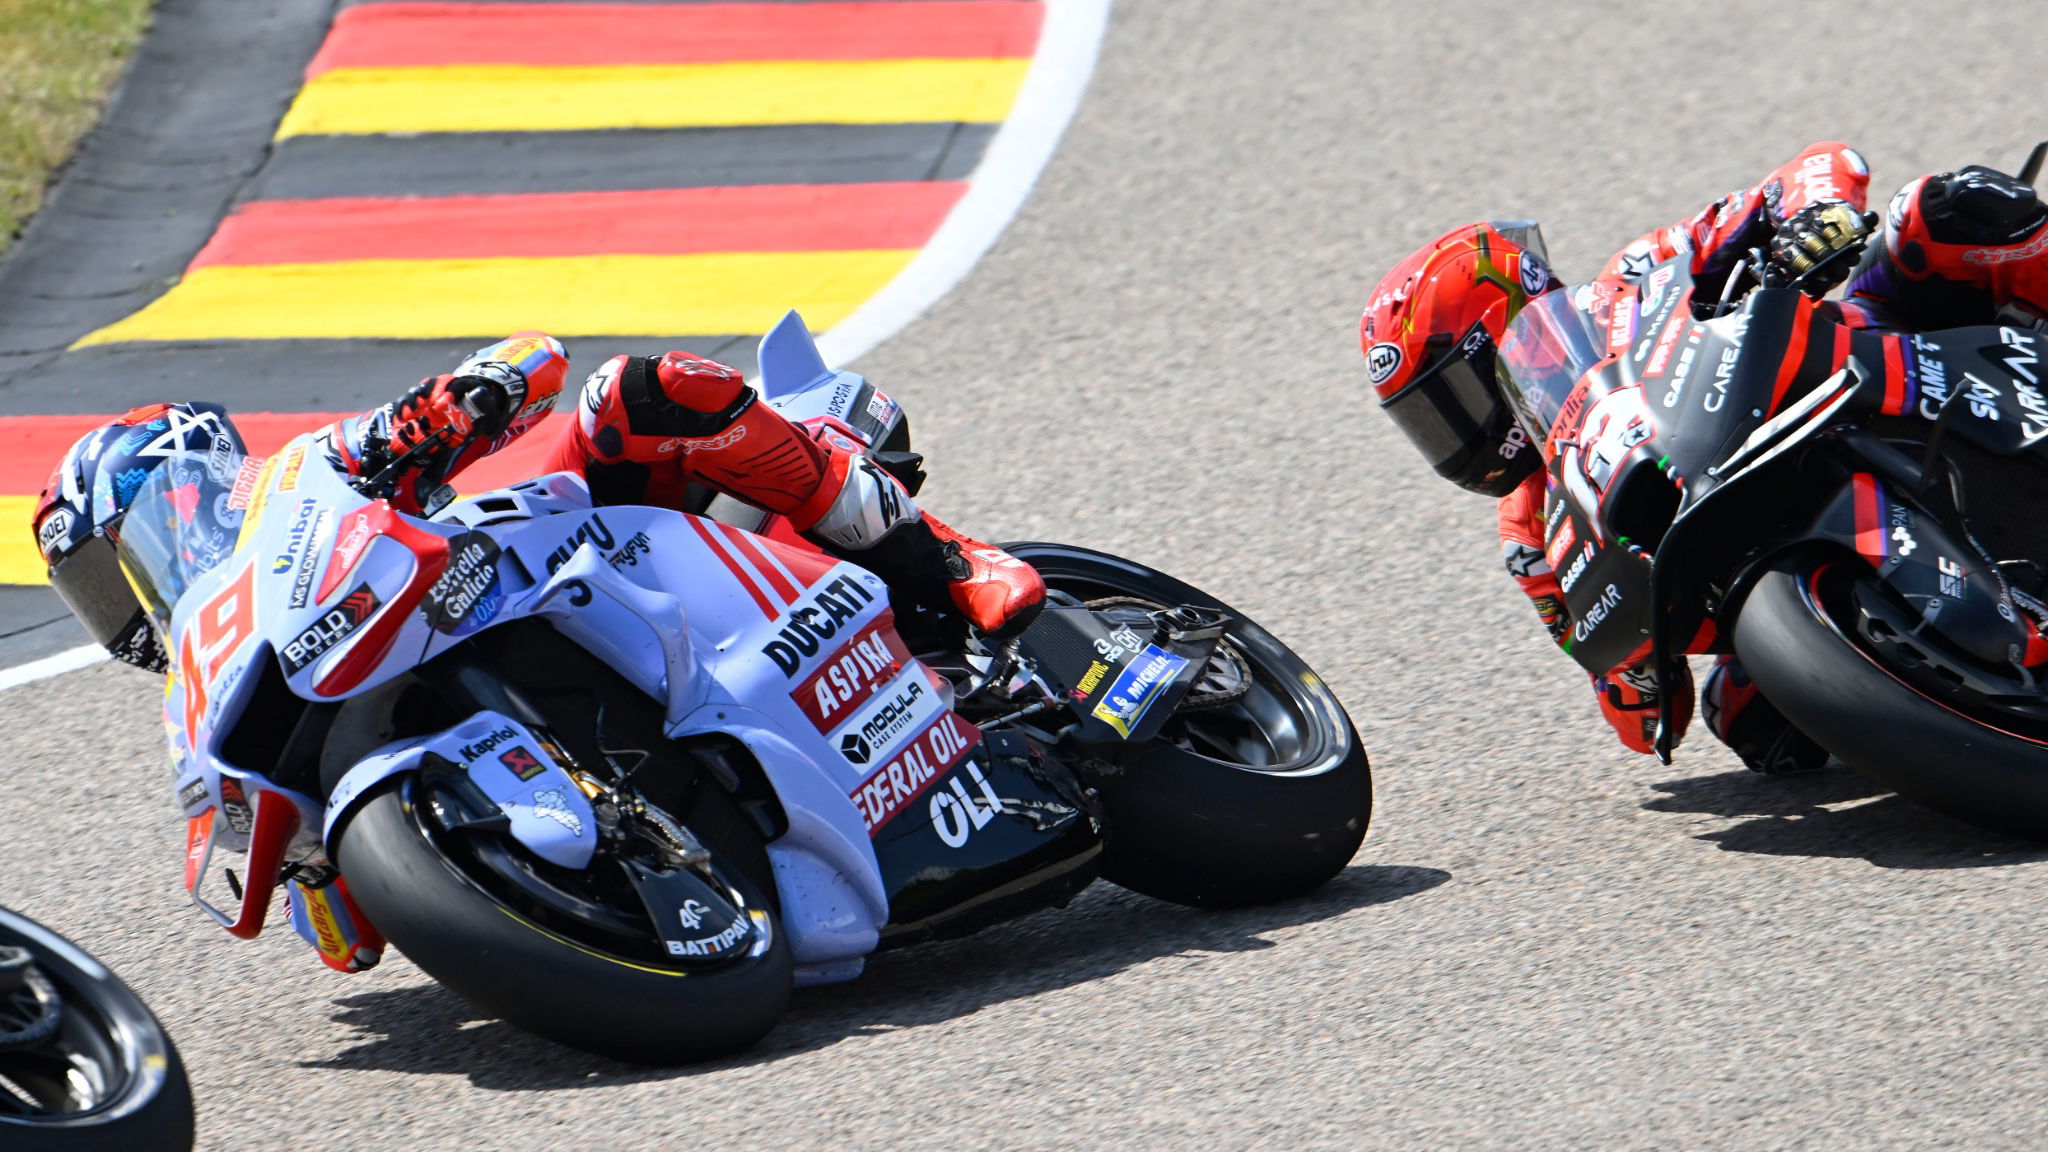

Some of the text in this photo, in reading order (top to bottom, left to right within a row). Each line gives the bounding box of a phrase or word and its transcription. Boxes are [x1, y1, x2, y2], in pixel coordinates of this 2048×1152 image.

[1704, 314, 1753, 412] CAREAR
[1919, 354, 1945, 421] CAME
[272, 498, 317, 574] Unibat
[428, 542, 486, 604] Estrella
[445, 564, 494, 619] Galicia
[284, 611, 347, 662] BOLD
[762, 574, 874, 679] DUCATI
[1575, 583, 1623, 642] CAREAR
[295, 623, 353, 669] RIDERS
[862, 681, 924, 738] MODULA
[873, 711, 914, 750] CASE SYSTEM
[459, 725, 518, 763] Kapriol
[853, 714, 967, 831] EDERAL OIL
[666, 914, 751, 956] BATTIPAV
